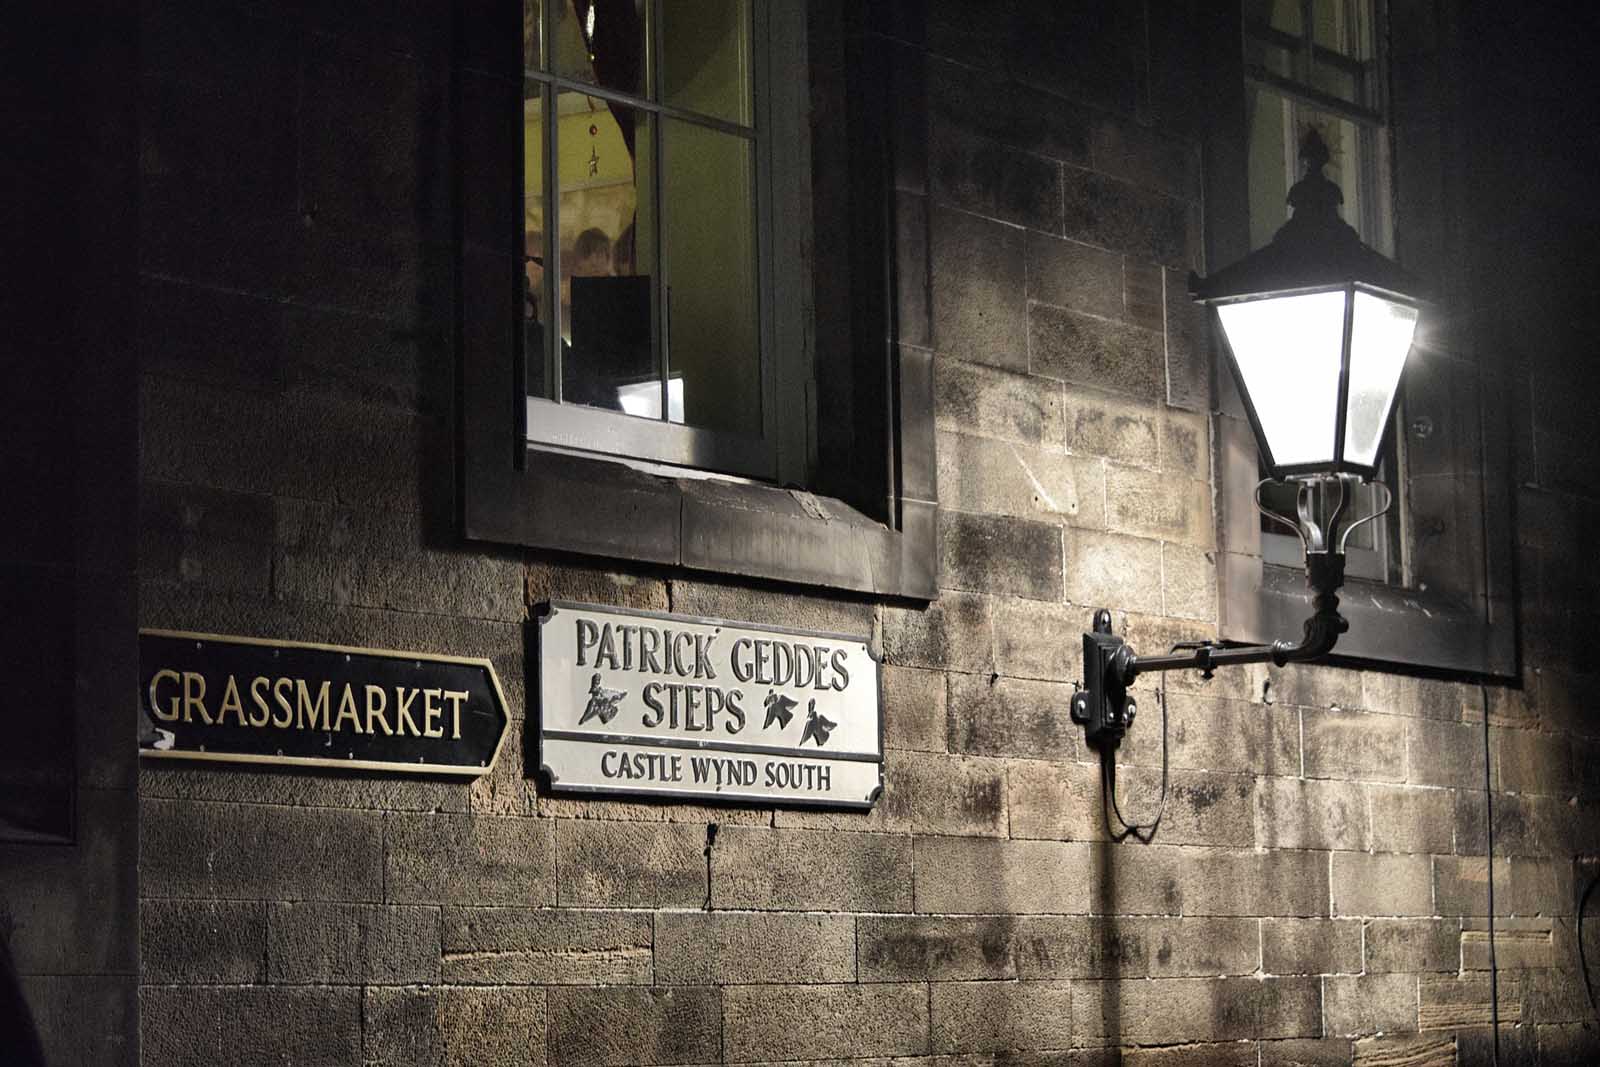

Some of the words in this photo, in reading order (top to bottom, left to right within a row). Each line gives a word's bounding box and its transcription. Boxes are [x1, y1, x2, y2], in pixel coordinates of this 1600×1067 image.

[576, 618, 717, 680] PATRICK
[731, 638, 850, 692] GEDDES
[150, 668, 469, 740] GRASSMARKET
[642, 682, 746, 735] STEPS
[601, 751, 682, 782] CASTLE
[691, 756, 757, 787] WYND
[765, 762, 831, 791] SOUTH
